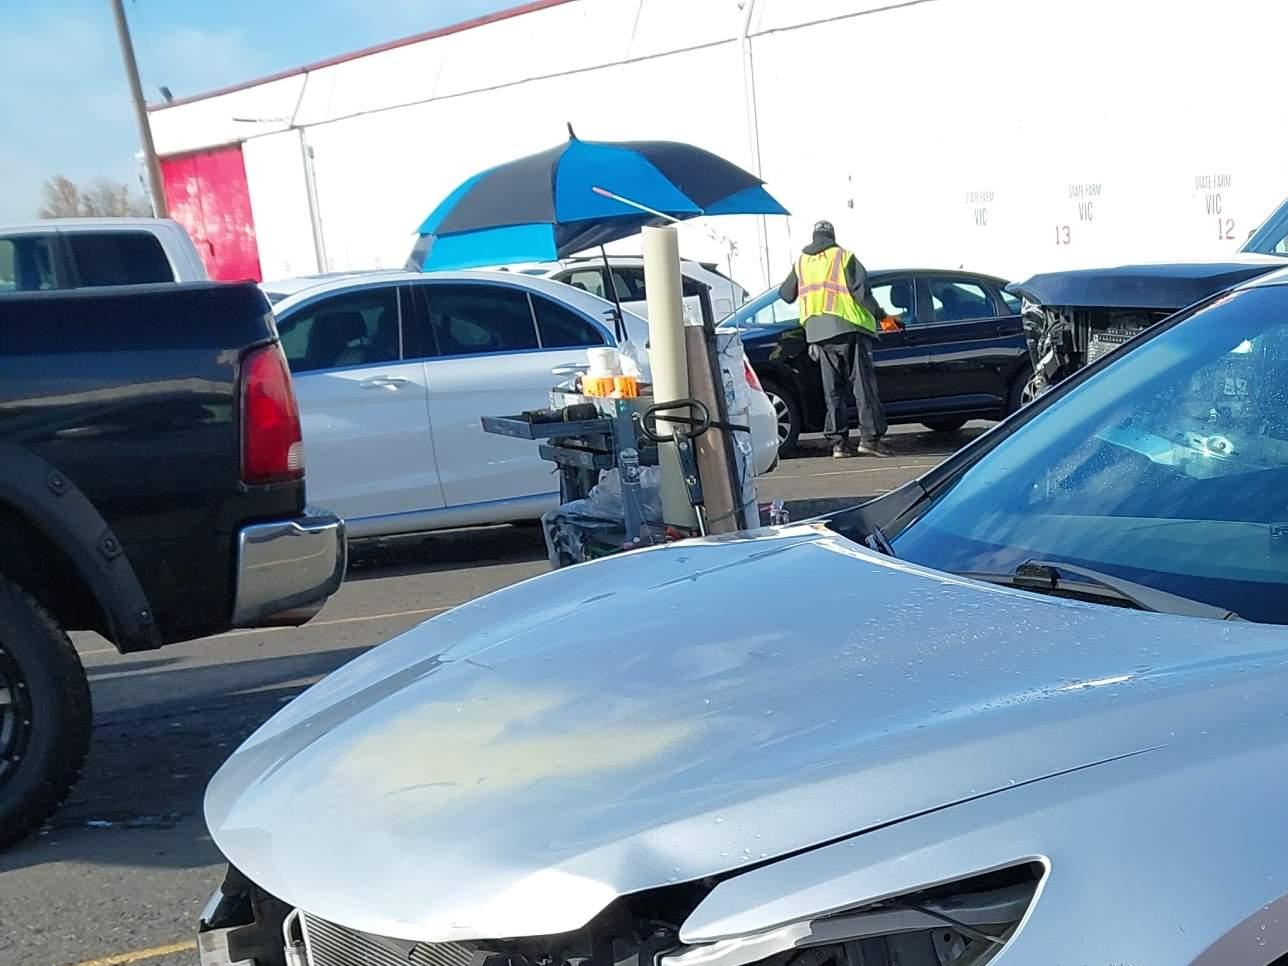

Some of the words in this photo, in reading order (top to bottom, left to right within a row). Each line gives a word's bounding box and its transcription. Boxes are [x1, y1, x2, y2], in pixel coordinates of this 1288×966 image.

[1068, 184, 1084, 198] STATE
[1085, 183, 1101, 196] FARM
[1195, 175, 1211, 190] STATE
[1213, 174, 1232, 188] FARM
[1078, 201, 1093, 221] VIC
[1205, 193, 1222, 215] VIC
[974, 207, 987, 226] VIC
[1056, 225, 1071, 245] 13
[1218, 218, 1236, 240] 12
